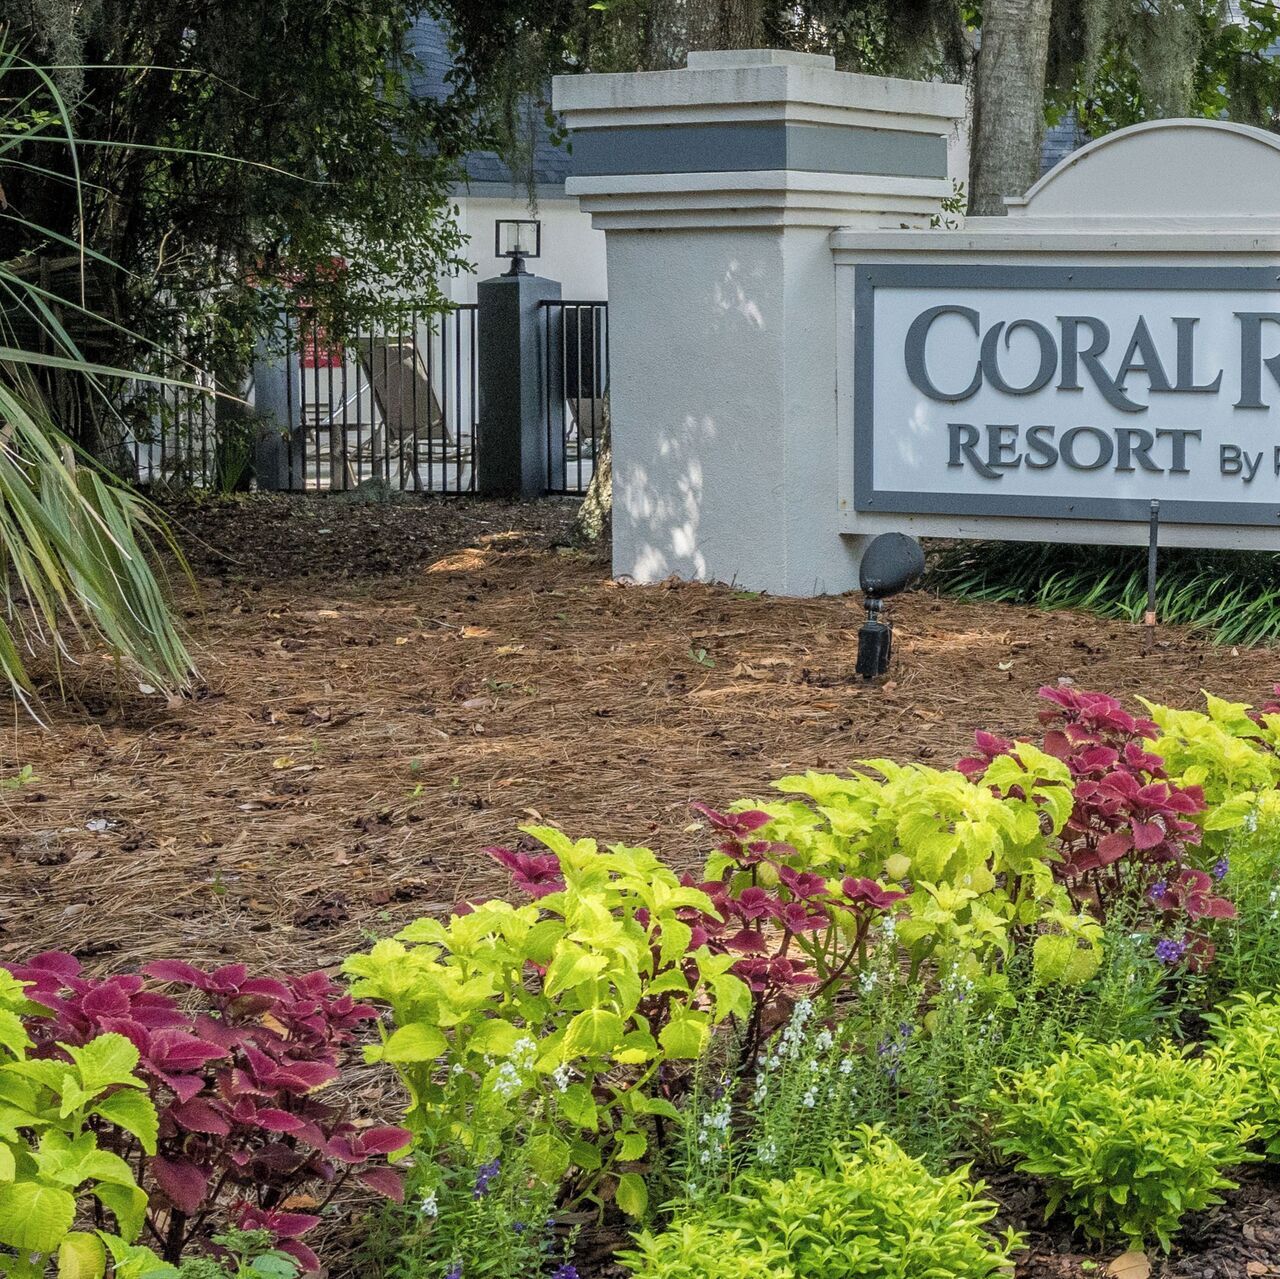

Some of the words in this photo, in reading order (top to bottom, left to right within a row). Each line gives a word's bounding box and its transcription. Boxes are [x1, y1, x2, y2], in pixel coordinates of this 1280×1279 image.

[904, 304, 1223, 412] CORAL
[946, 423, 1202, 479] RESORT
[1219, 444, 1264, 482] By
